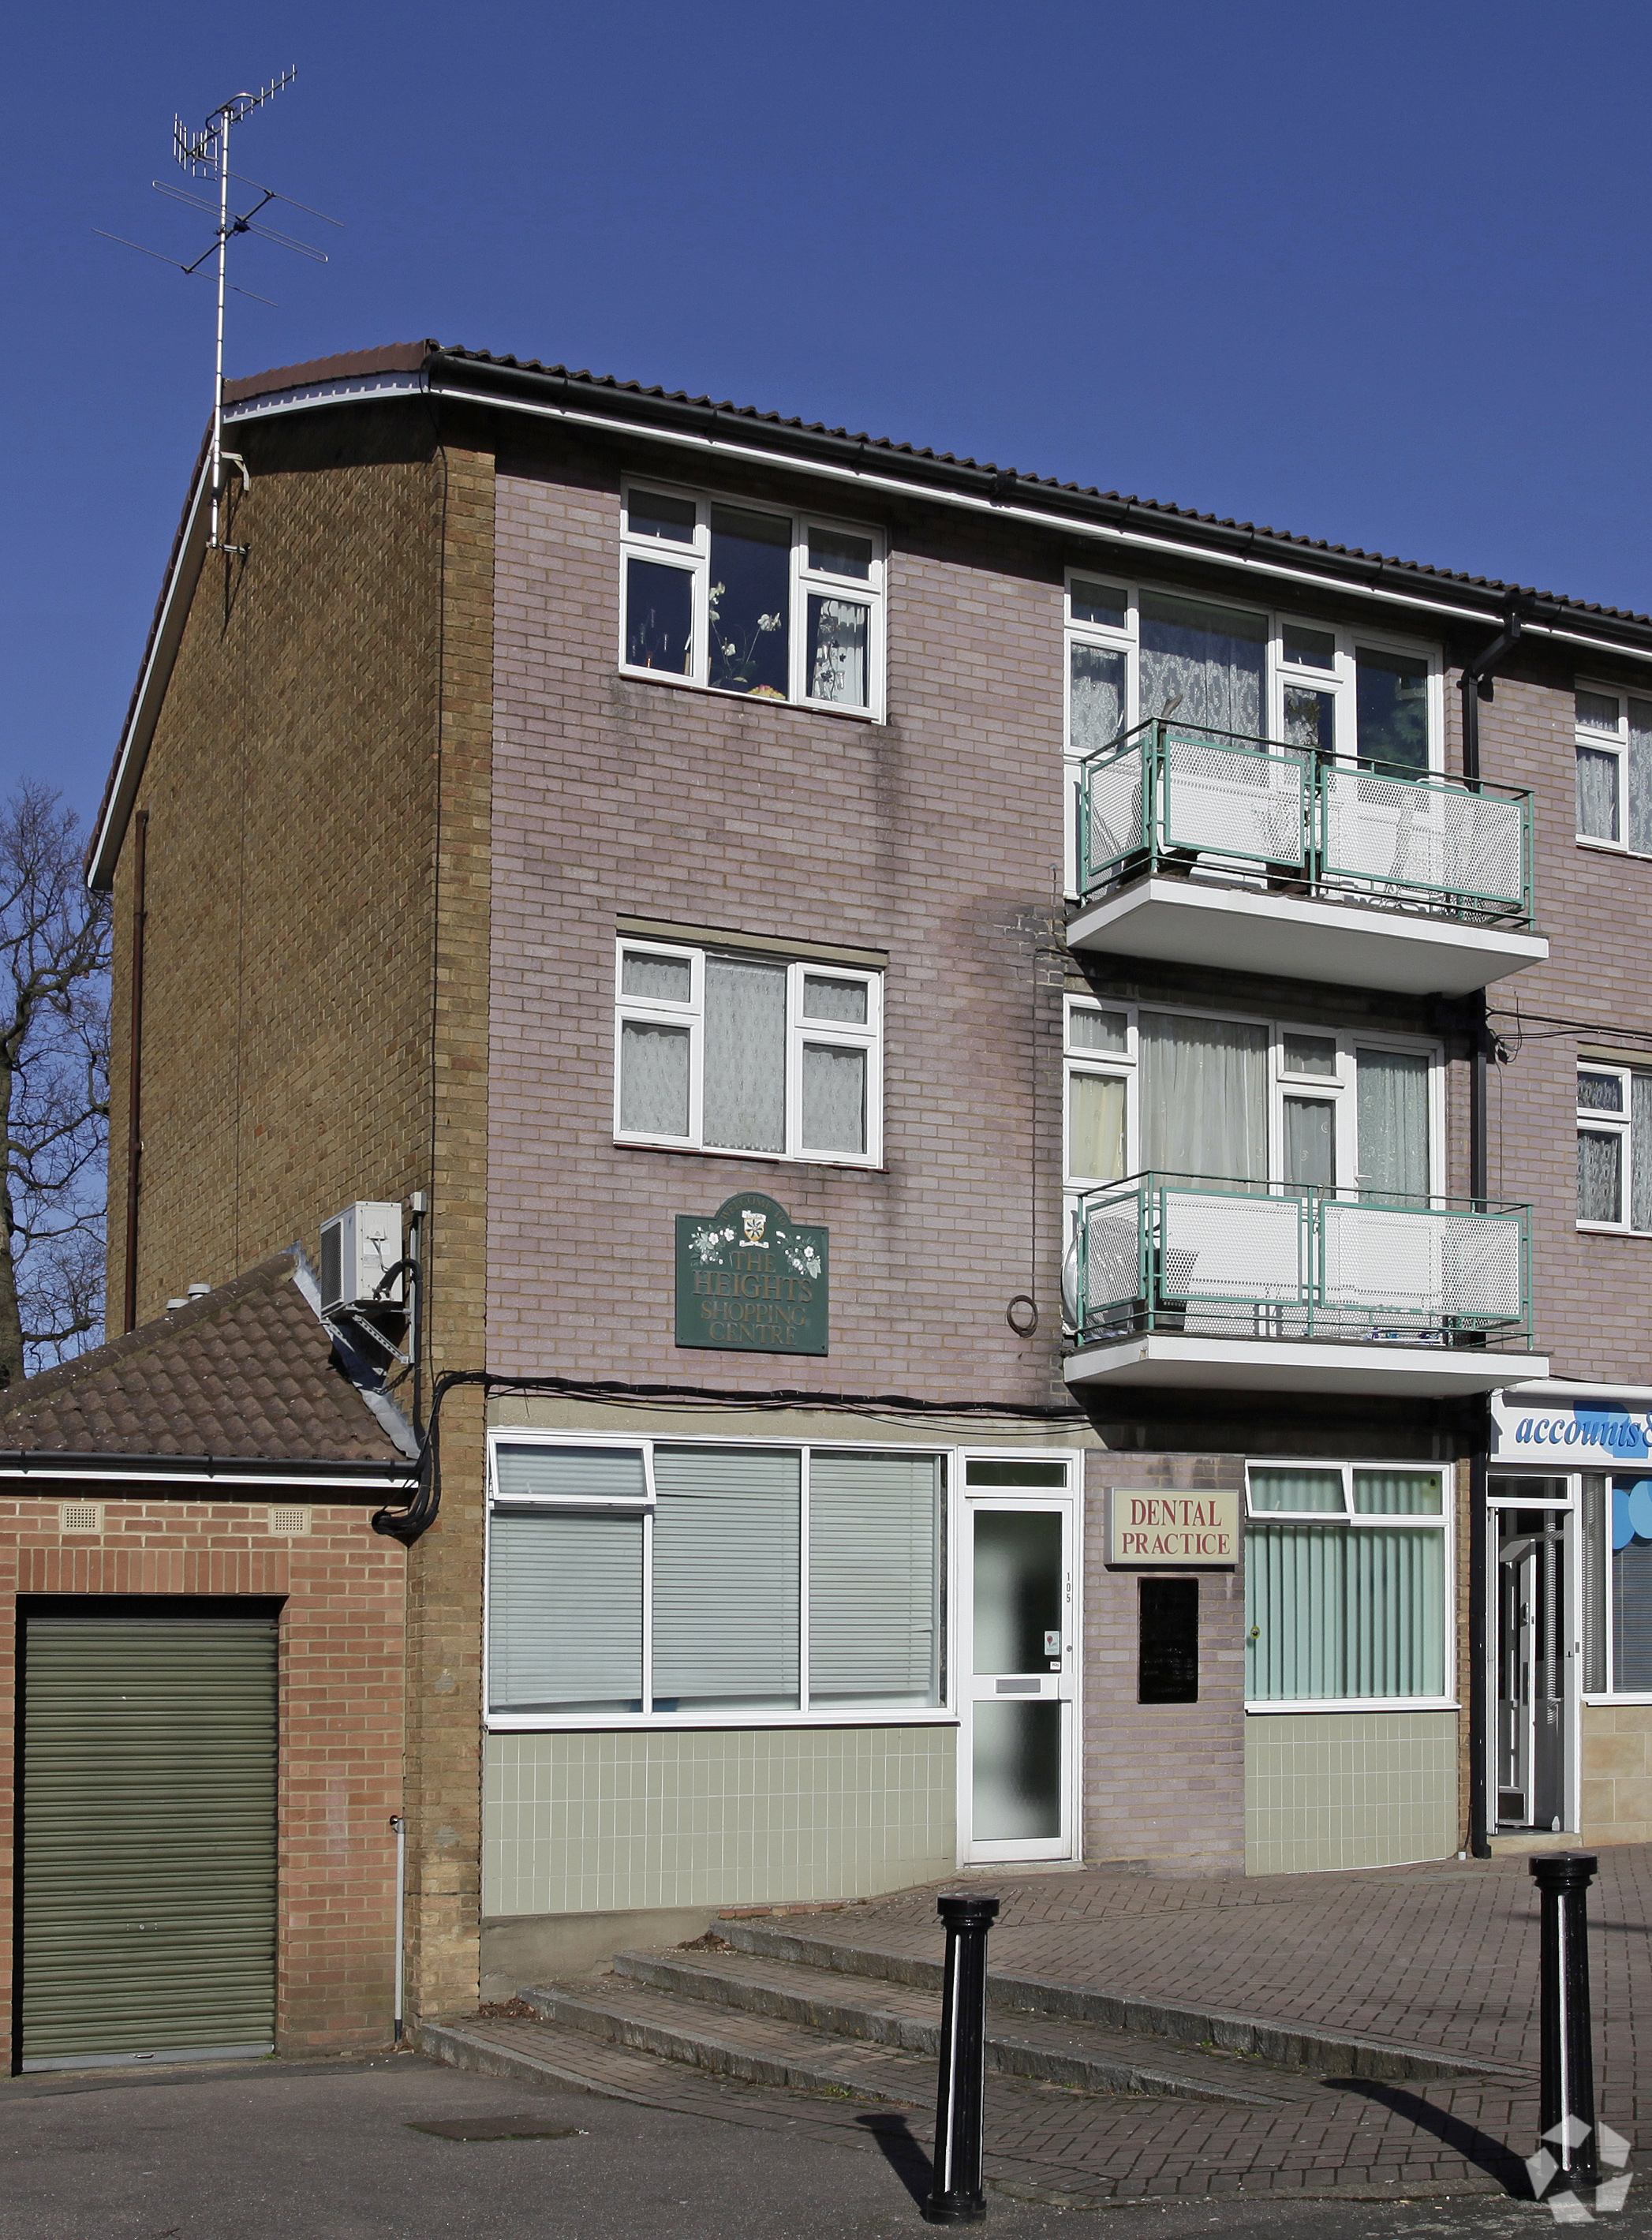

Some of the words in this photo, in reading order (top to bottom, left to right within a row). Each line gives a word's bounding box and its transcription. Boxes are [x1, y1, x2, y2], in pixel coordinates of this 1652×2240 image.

[720, 1196, 772, 1220] WELCOME
[775, 1210, 787, 1226] TO
[731, 1251, 776, 1273] THE
[692, 1270, 813, 1303] HEIGHTS
[701, 1300, 805, 1326] SHOPPING
[710, 1322, 797, 1346] CENTRE
[1131, 1499, 1222, 1527] DENTAL
[1122, 1533, 1231, 1555] PRACTICE
